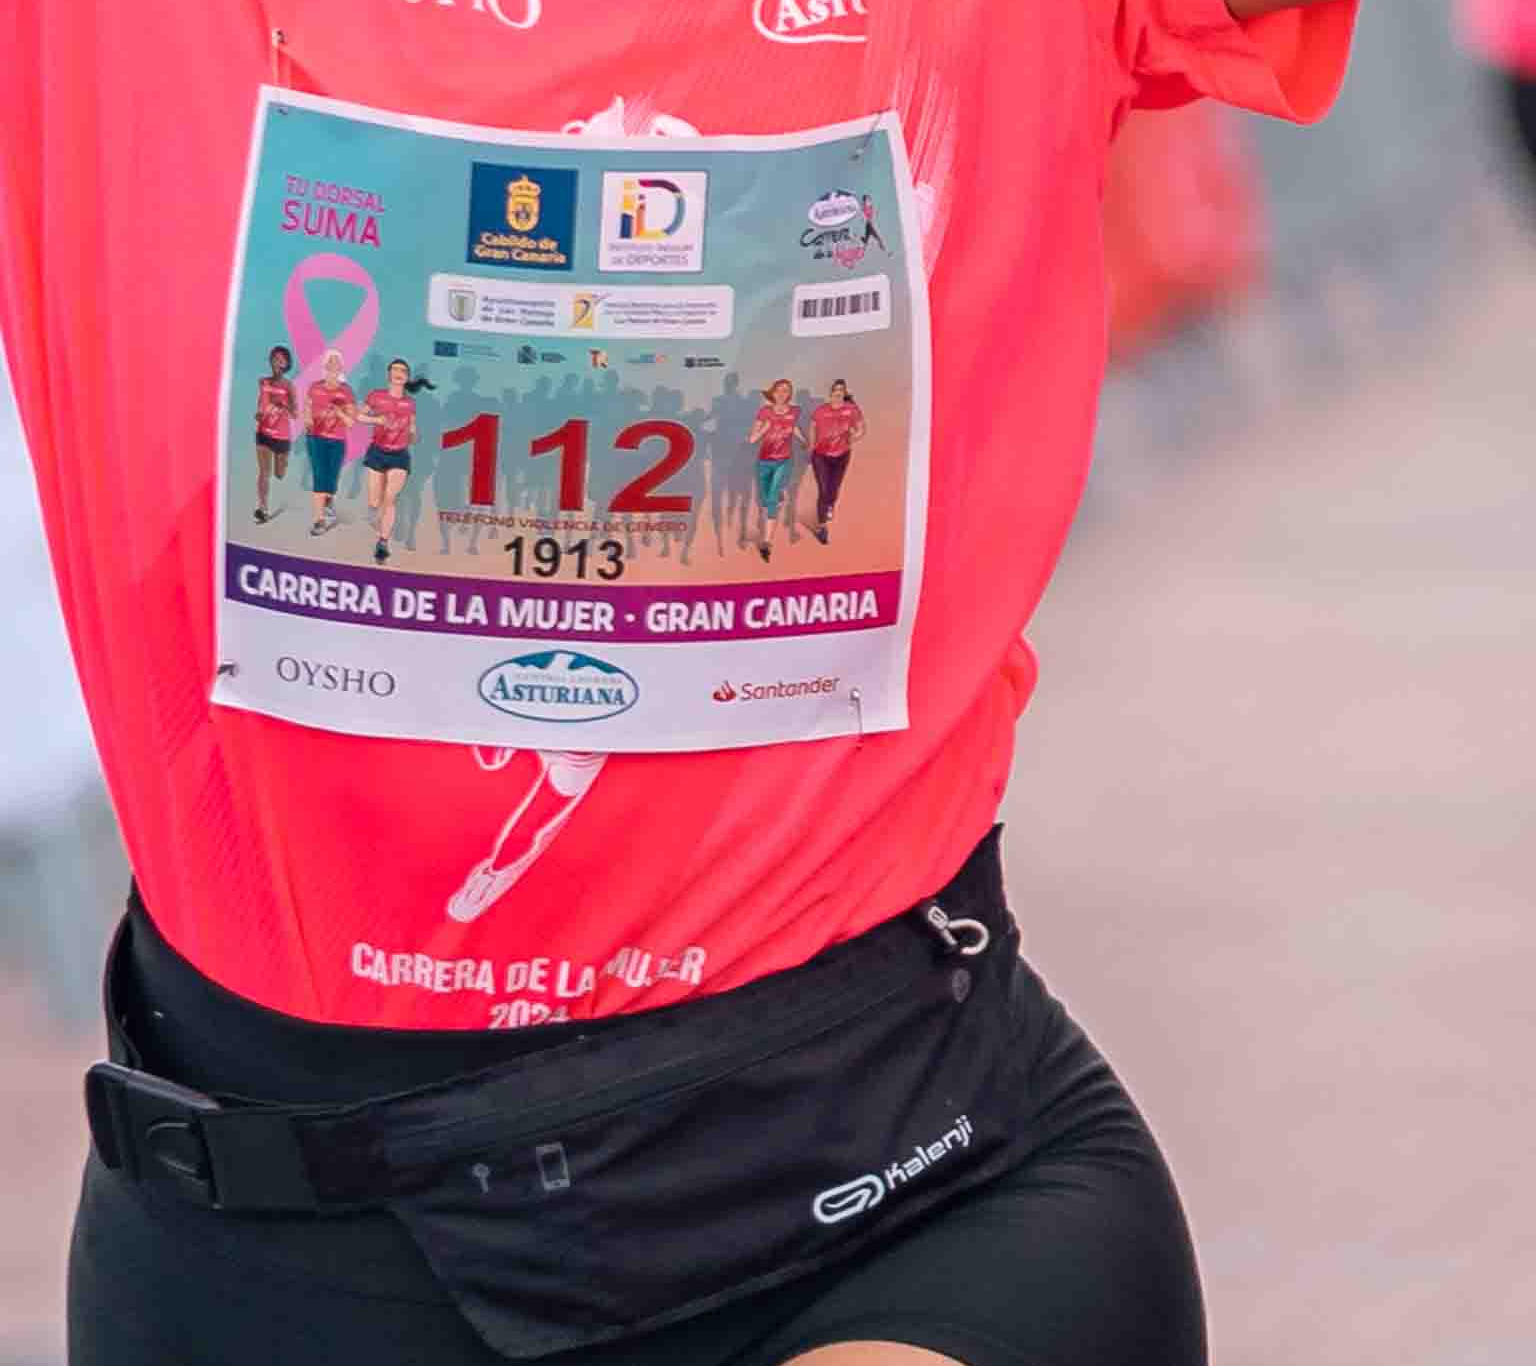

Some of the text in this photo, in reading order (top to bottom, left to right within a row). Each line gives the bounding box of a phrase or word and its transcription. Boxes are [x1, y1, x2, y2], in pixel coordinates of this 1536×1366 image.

[281, 199, 381, 248] SUMA
[442, 413, 695, 513] 112
[504, 536, 625, 580] 1913
[239, 564, 879, 633] CARRERA DE LA MUJER GRAN CANARIA
[276, 655, 397, 697] OYSHO
[489, 674, 627, 706] ASTURIANA
[740, 674, 840, 702] Santander
[351, 941, 496, 995] CARRERA
[506, 956, 550, 994] DE
[556, 959, 596, 999] LA
[884, 1114, 974, 1191] Kalenji
